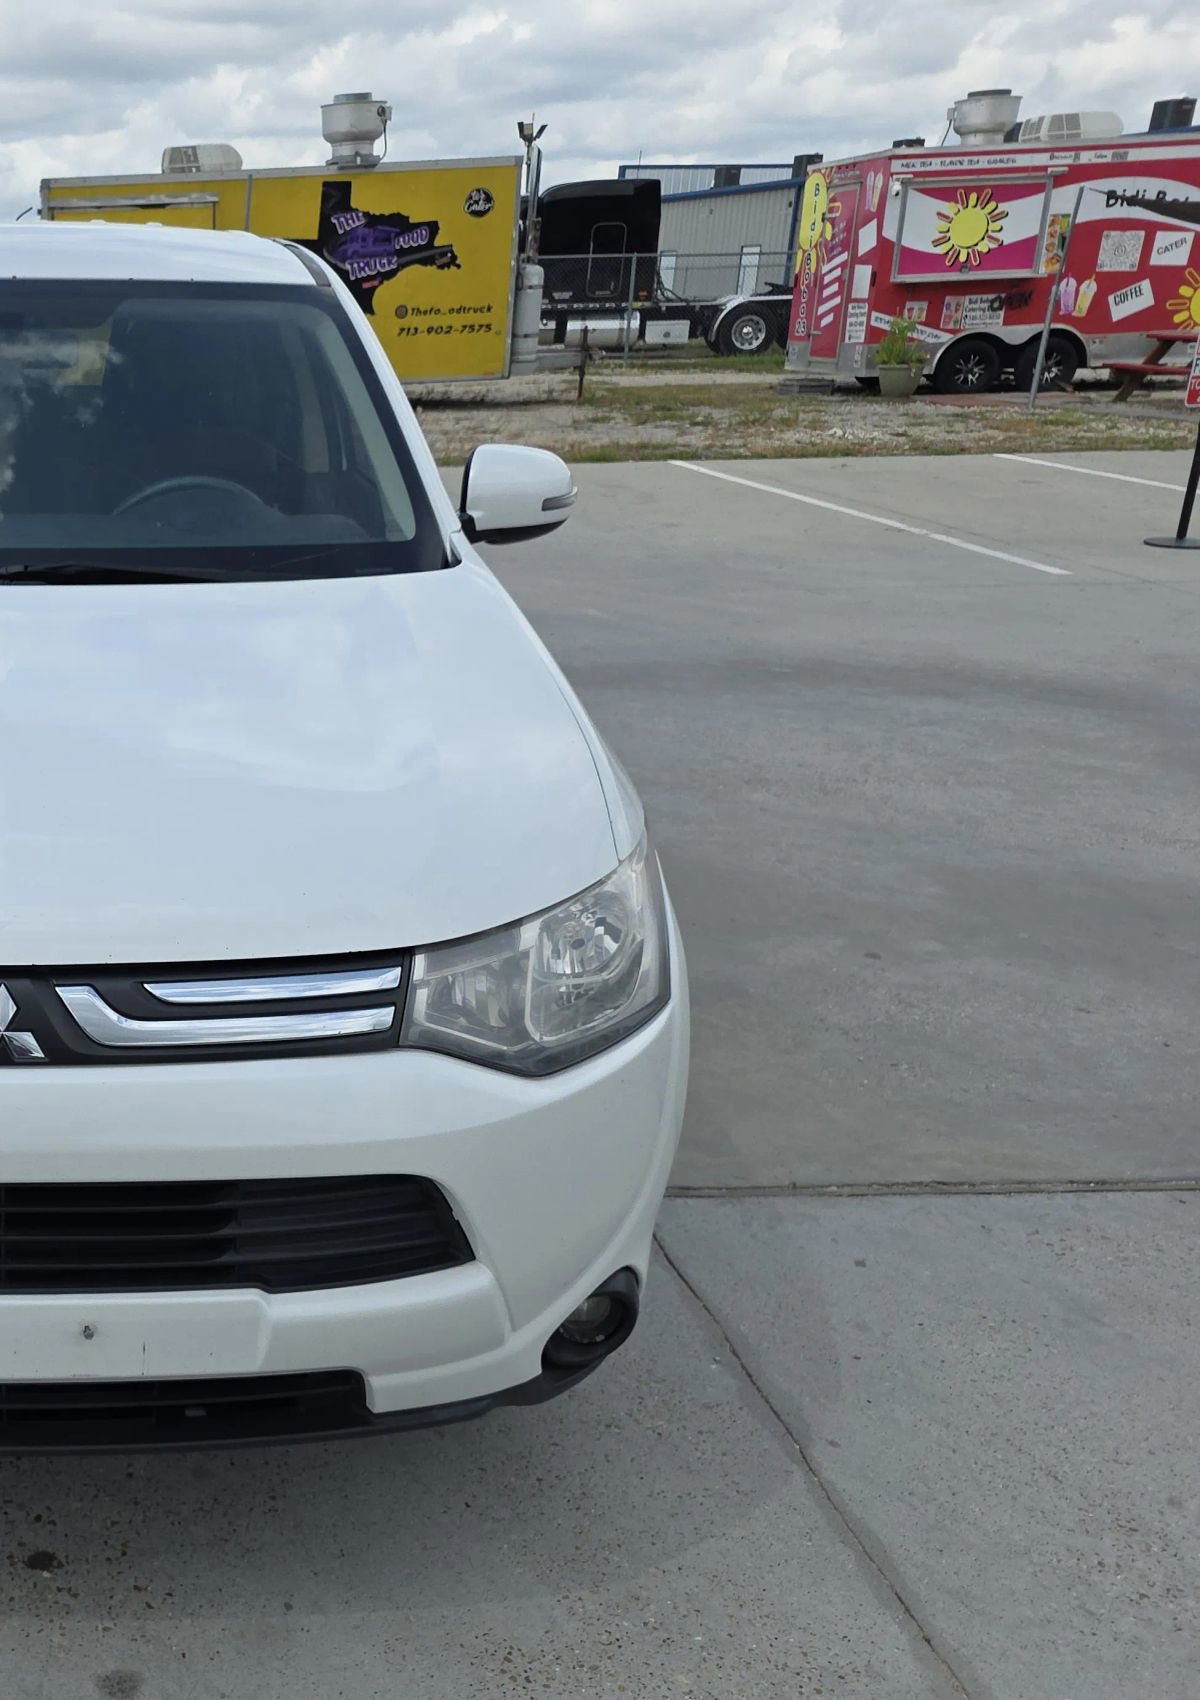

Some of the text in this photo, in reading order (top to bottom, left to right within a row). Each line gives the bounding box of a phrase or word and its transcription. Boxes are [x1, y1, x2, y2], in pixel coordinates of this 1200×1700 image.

[330, 211, 367, 235] THE
[394, 225, 430, 250] FOOD
[1156, 237, 1188, 256] CATER
[345, 255, 398, 281] TRUCK
[1113, 284, 1144, 306] COFFEE
[397, 323, 493, 337] 713-902-7575
